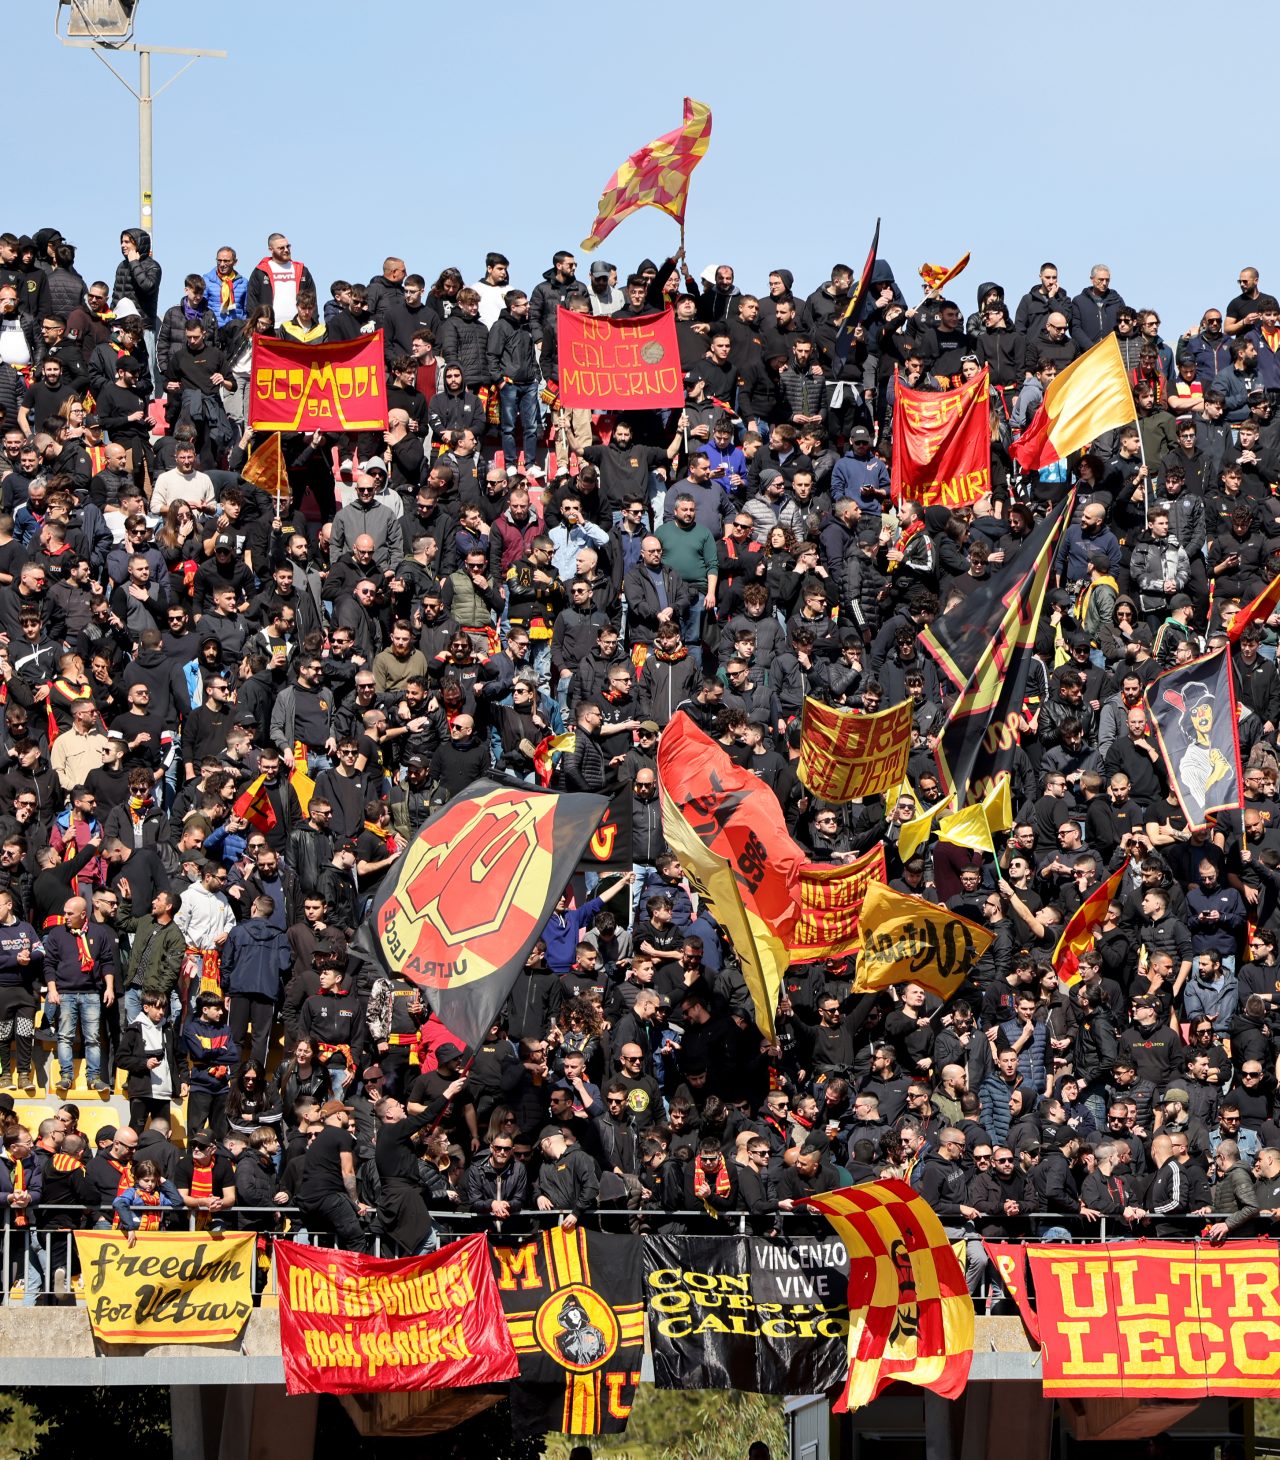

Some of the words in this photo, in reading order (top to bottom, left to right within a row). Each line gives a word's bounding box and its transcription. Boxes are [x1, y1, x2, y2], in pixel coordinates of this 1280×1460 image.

[563, 367, 677, 396] MODERNO
[91, 1243, 244, 1294] freedom
[755, 1242, 847, 1270] VINCENZO
[289, 1264, 339, 1316] mai
[648, 1268, 751, 1292] CON
[775, 1275, 830, 1298] VIVE
[91, 1296, 132, 1325] for
[657, 1313, 850, 1339] CALCIO
[304, 1323, 362, 1368] mai
[360, 1314, 475, 1378] pentirsi
